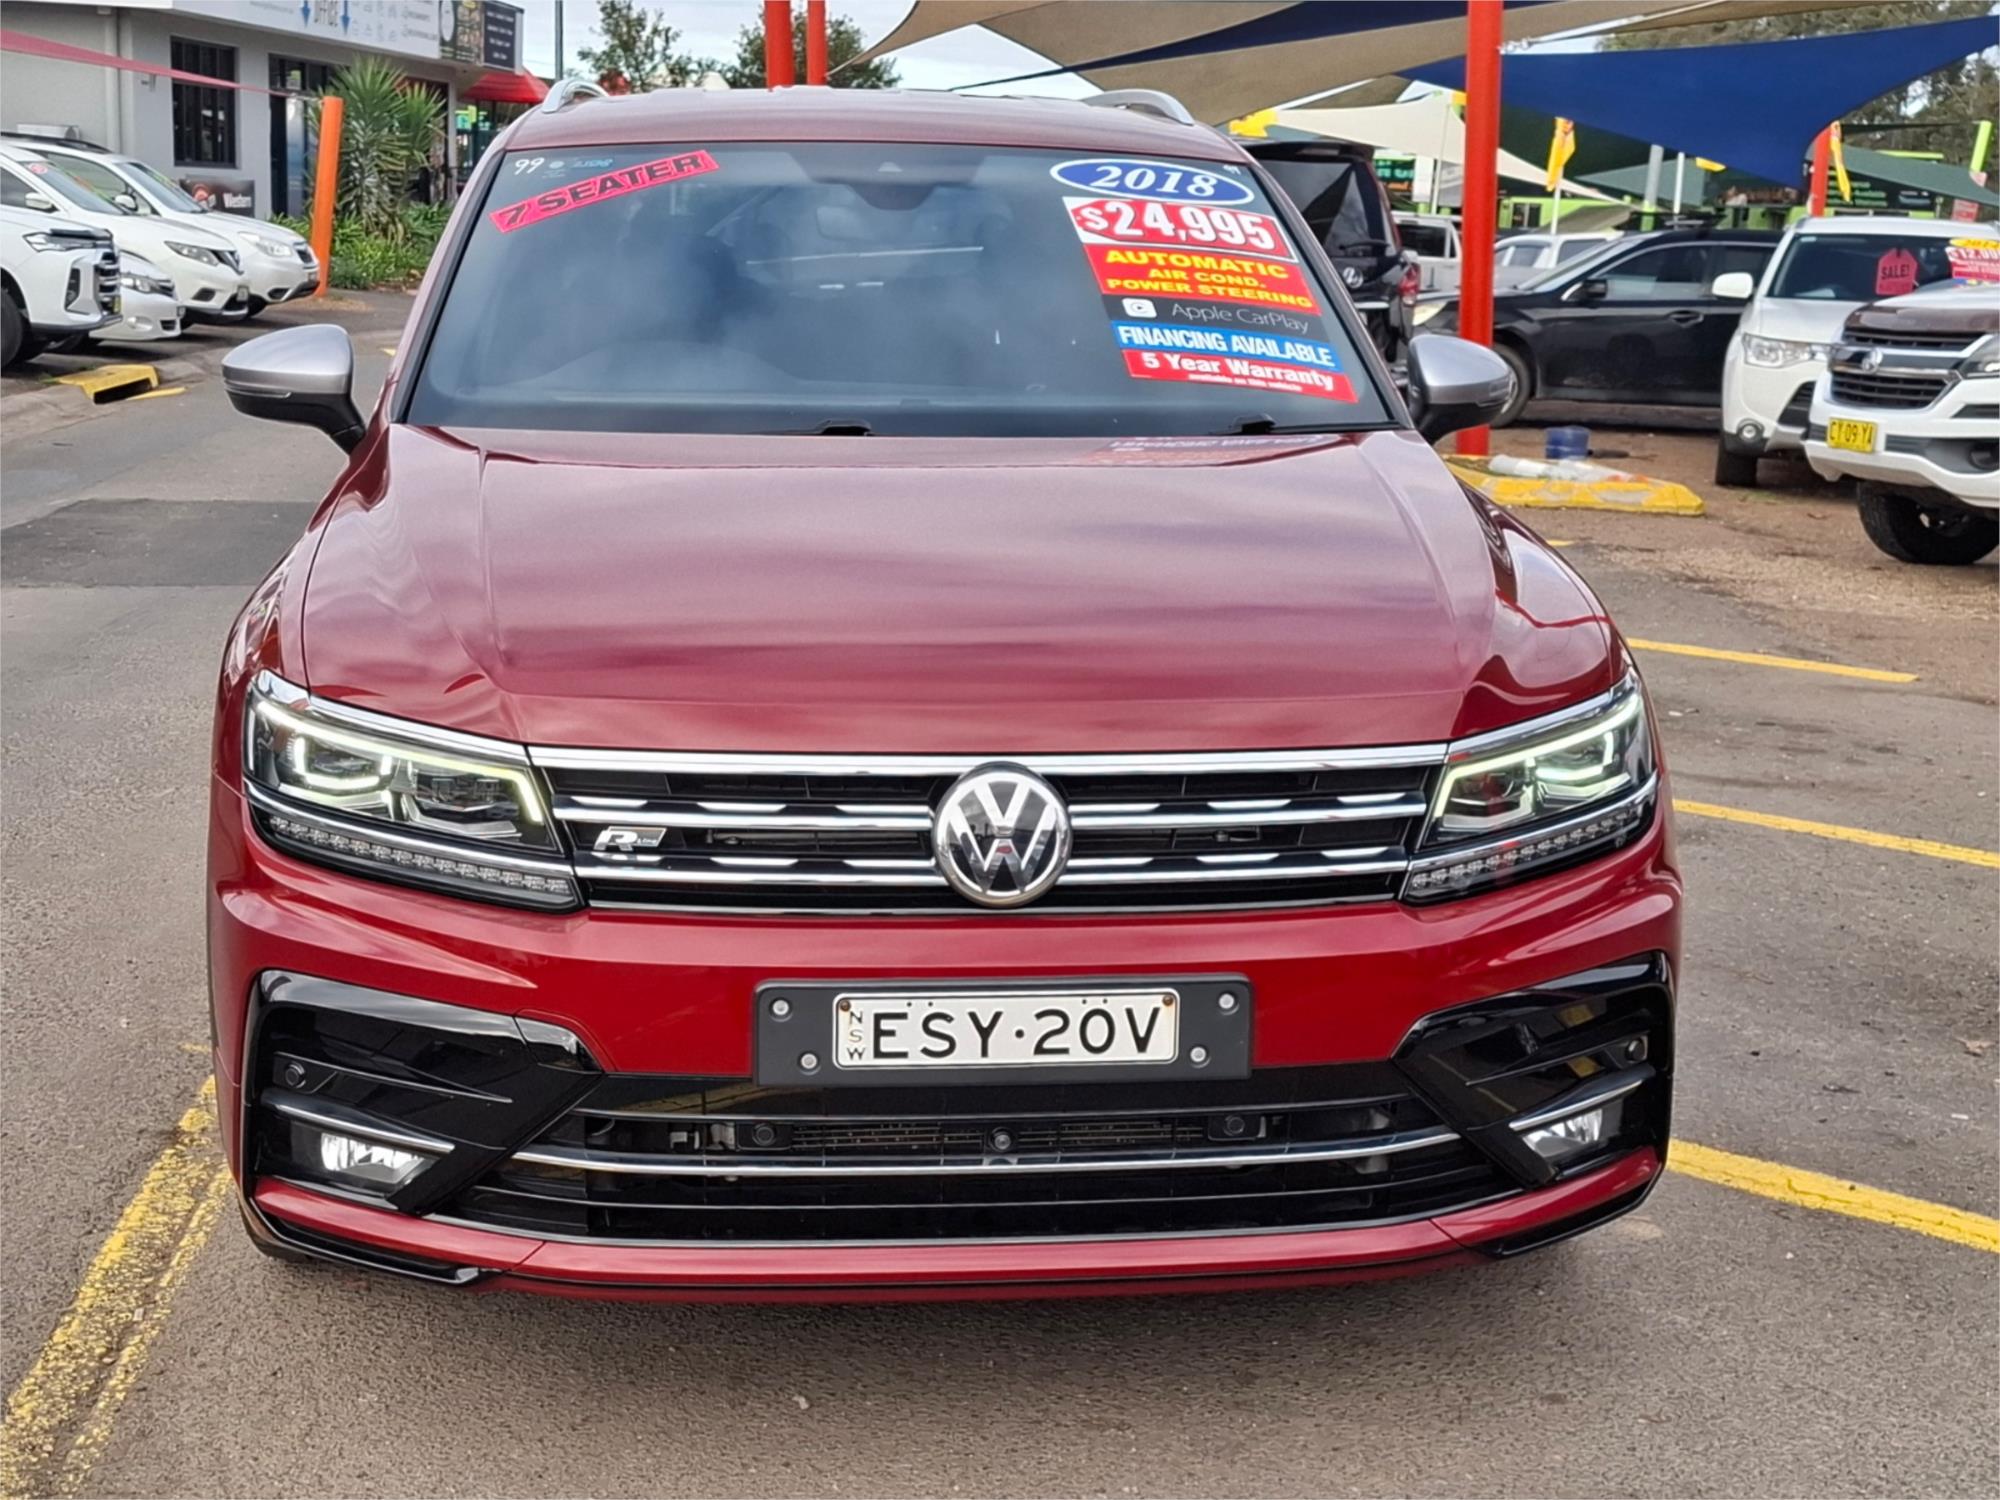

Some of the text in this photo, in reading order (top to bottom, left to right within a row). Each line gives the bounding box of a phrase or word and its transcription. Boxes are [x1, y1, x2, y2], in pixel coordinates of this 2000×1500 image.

[514, 157, 545, 176] 99
[1089, 165, 1219, 198] 2018
[498, 154, 704, 226] 7 SEATER
[1079, 201, 1276, 250] $24,995
[1106, 249, 1289, 279] AUTOMATIC
[1148, 268, 1266, 288] AIR COND.
[1106, 279, 1313, 308] POWER STEERING
[1172, 302, 1310, 334] Apple CarPlay
[1117, 326, 1336, 368] FINANCING AVAILABLE
[1142, 353, 1335, 392] 5 Year Warranty
[847, 1010, 866, 1061] NSW
